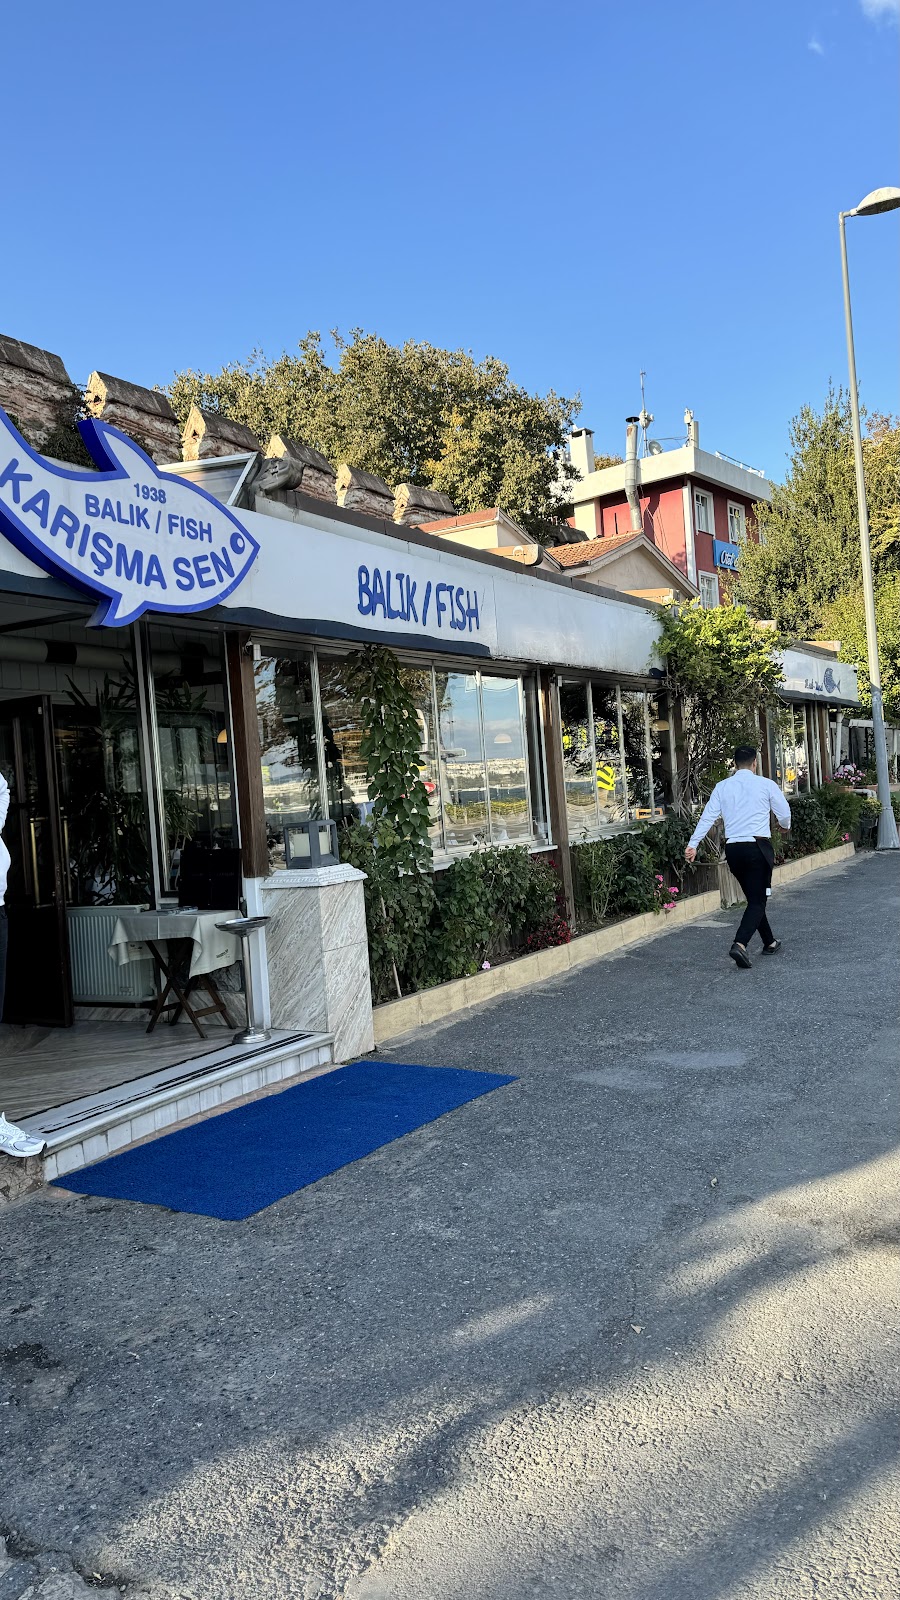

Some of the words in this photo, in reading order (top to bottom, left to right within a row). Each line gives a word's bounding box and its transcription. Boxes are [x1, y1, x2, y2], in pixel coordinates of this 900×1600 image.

[133, 483, 167, 504] 1938
[0, 458, 167, 590] KARIŞMA
[173, 547, 235, 592] SEN
[85, 494, 150, 530] BALIK
[168, 513, 213, 544] FISH
